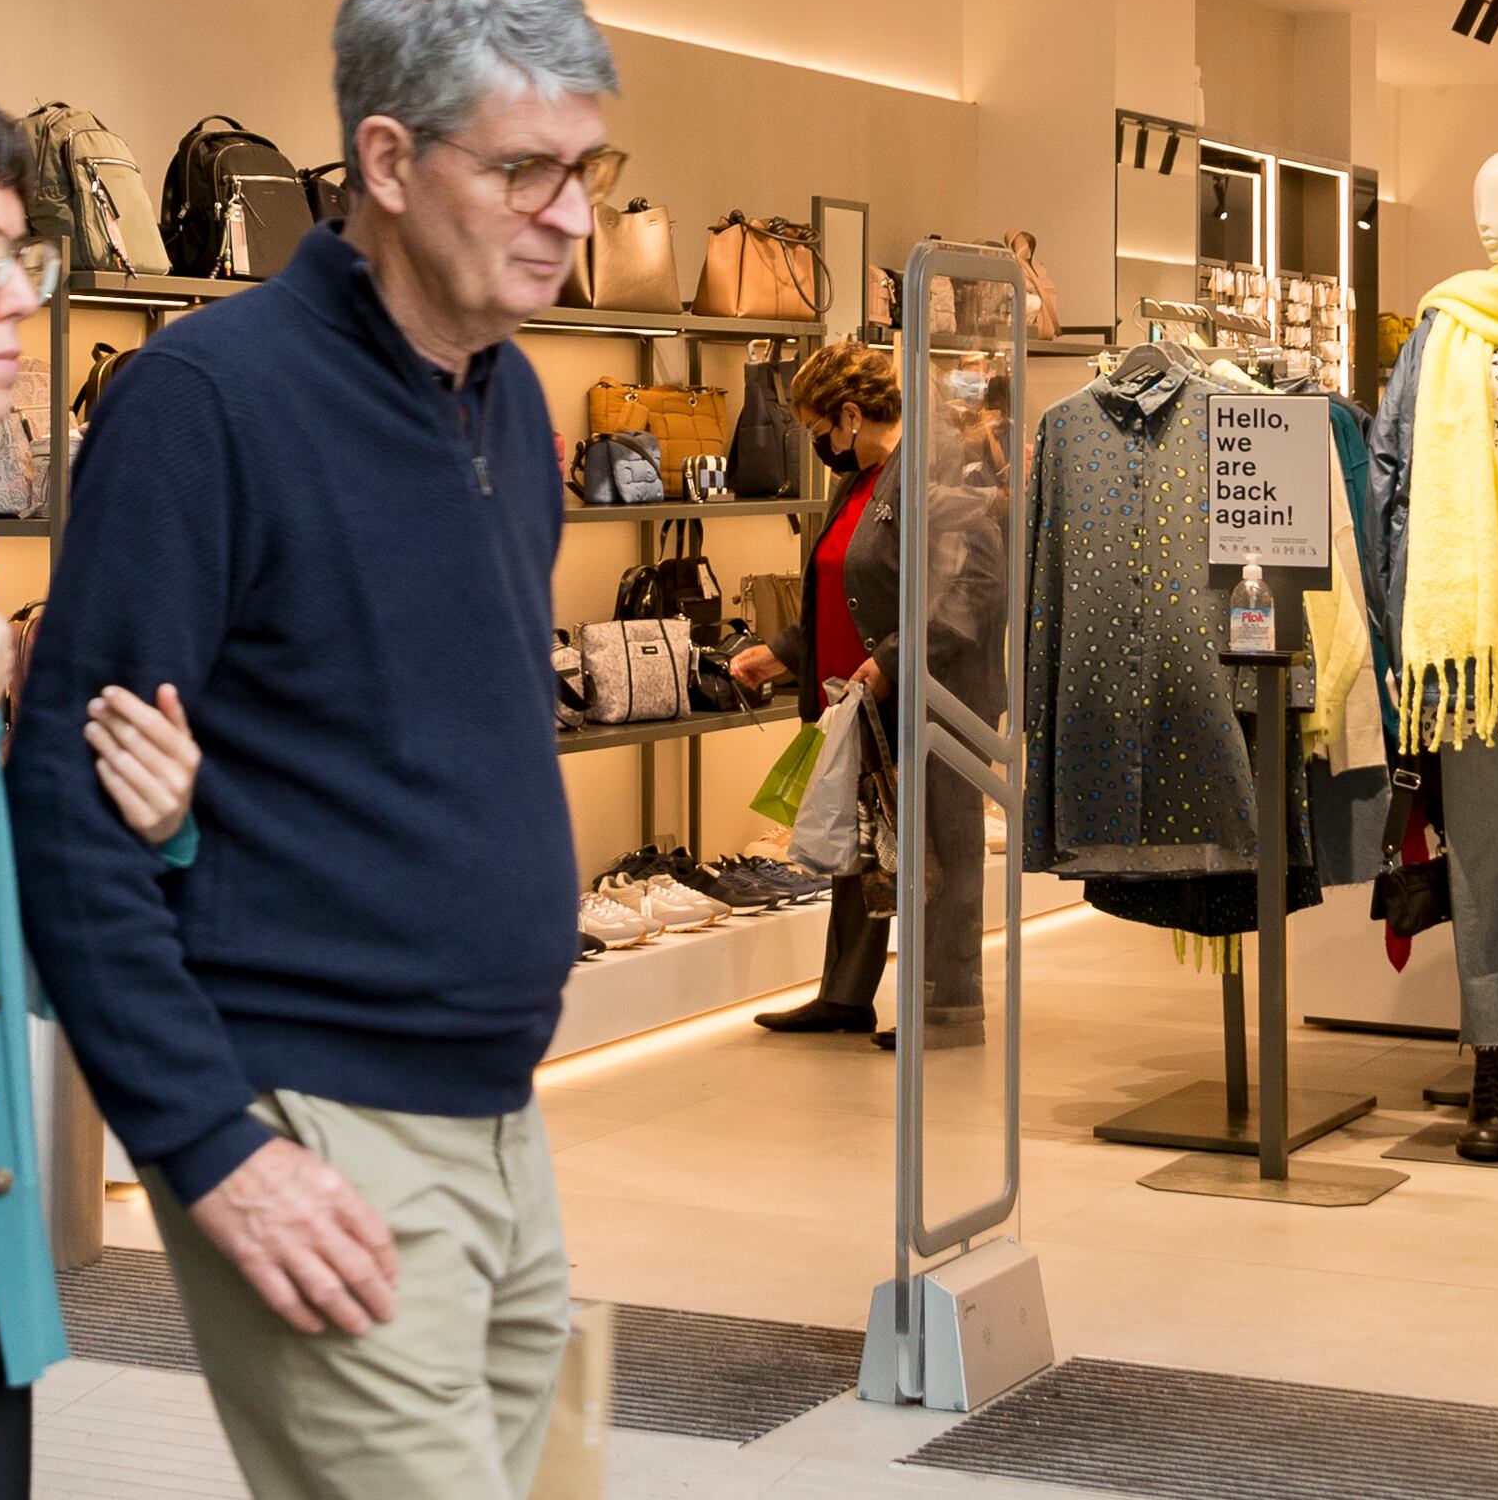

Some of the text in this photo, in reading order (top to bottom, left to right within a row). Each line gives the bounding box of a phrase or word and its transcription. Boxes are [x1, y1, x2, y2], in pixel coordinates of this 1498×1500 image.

[1216, 407, 1289, 432] Hello,
[1216, 436, 1252, 452] we
[1216, 460, 1256, 476] are
[1216, 480, 1277, 501] back
[1216, 506, 1293, 528] again!
